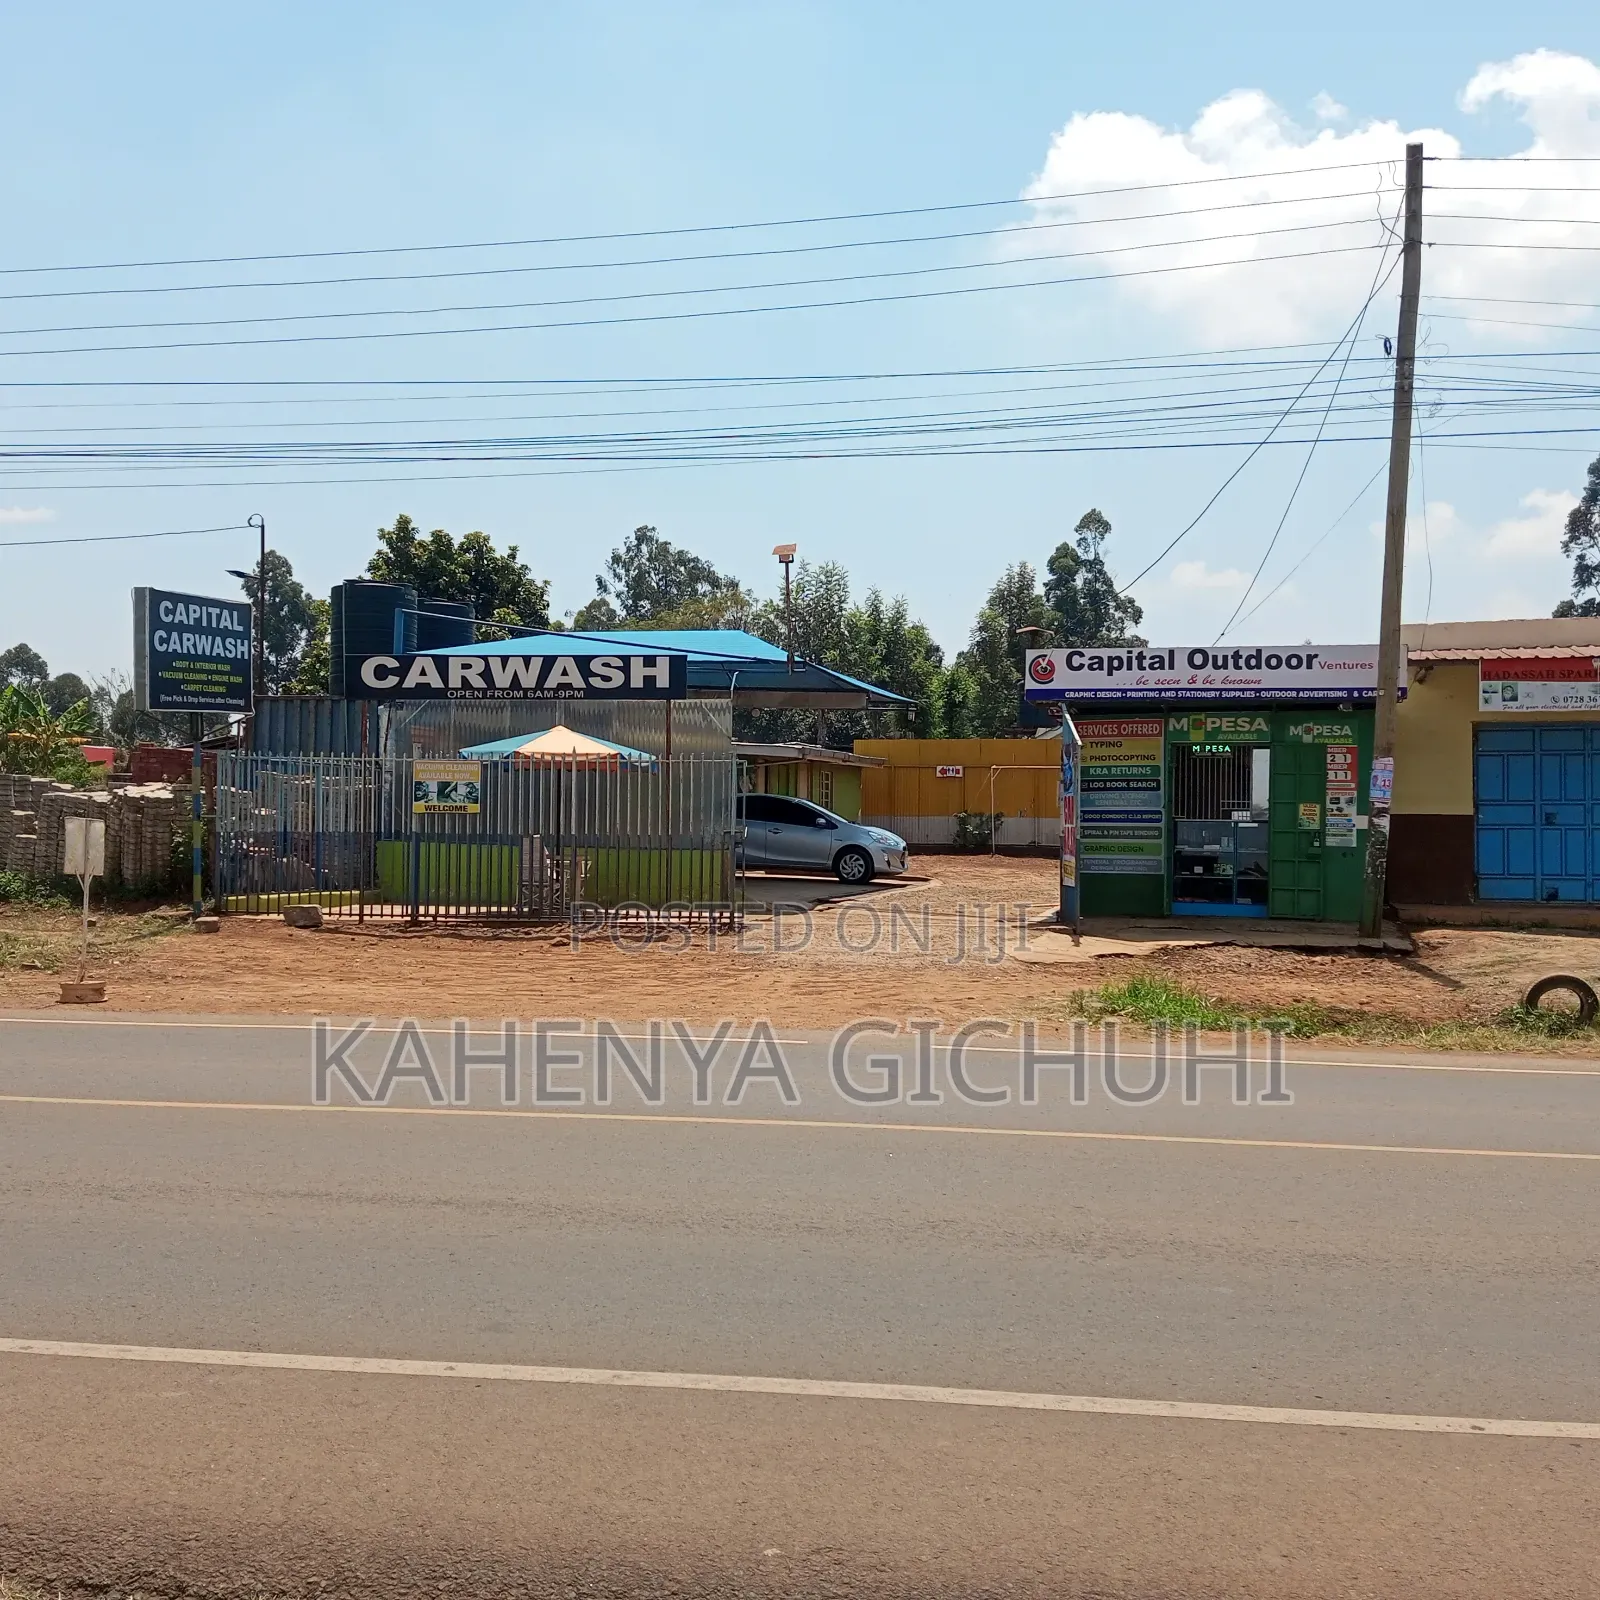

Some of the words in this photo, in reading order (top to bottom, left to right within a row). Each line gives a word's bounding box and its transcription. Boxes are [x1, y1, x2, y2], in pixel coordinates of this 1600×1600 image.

[159, 600, 244, 632] CAPITAL
[153, 629, 249, 660] CARWASH
[195, 662, 217, 670] INTERIOR
[1065, 649, 1175, 676] Capital
[1187, 648, 1319, 671] Outdoor
[1319, 660, 1374, 670] Ventures
[162, 671, 183, 679] VACUUM
[360, 656, 670, 689] CARWASH
[1483, 670, 1555, 680] HADASSAH
[1187, 674, 1197, 684] &
[1202, 674, 1216, 685] be
[1221, 675, 1262, 685] known
[448, 690, 484, 698] OPEN
[486, 690, 524, 698] FROM
[527, 689, 584, 698] 6AM-9PM
[1078, 724, 1118, 736] SERVICES
[1121, 723, 1160, 735] OFFERED
[1089, 741, 1123, 749] TYPING
[1090, 767, 1110, 775] KRA
[1111, 766, 1151, 775] RETURNS
